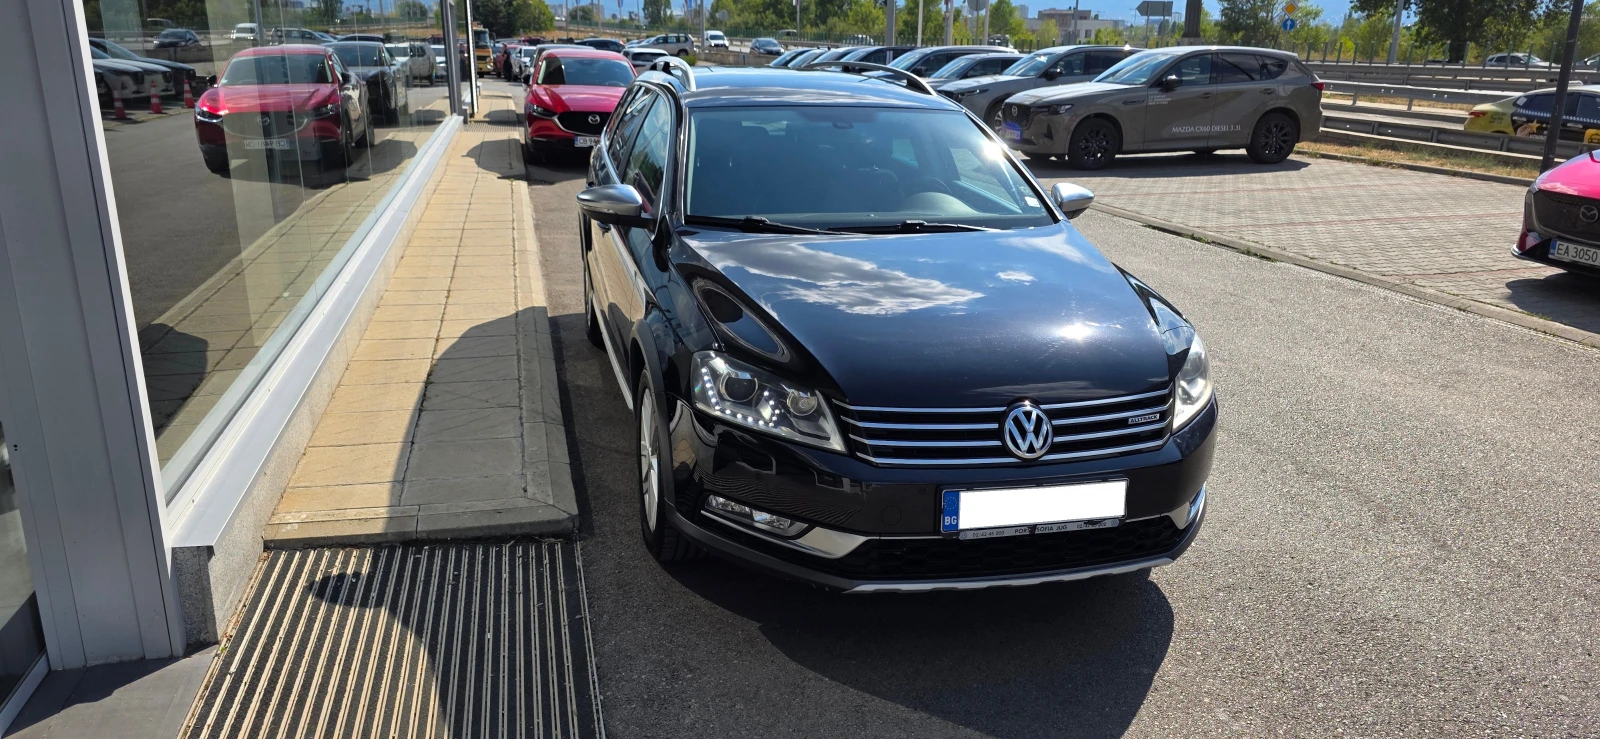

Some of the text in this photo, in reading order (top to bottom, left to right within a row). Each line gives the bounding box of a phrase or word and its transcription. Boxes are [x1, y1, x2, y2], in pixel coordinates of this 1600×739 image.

[1556, 243, 1598, 263] EA 3050
[1129, 414, 1159, 424] ALLTRACK
[944, 515, 957, 525] BG
[1036, 525, 1054, 533] SOFIA
